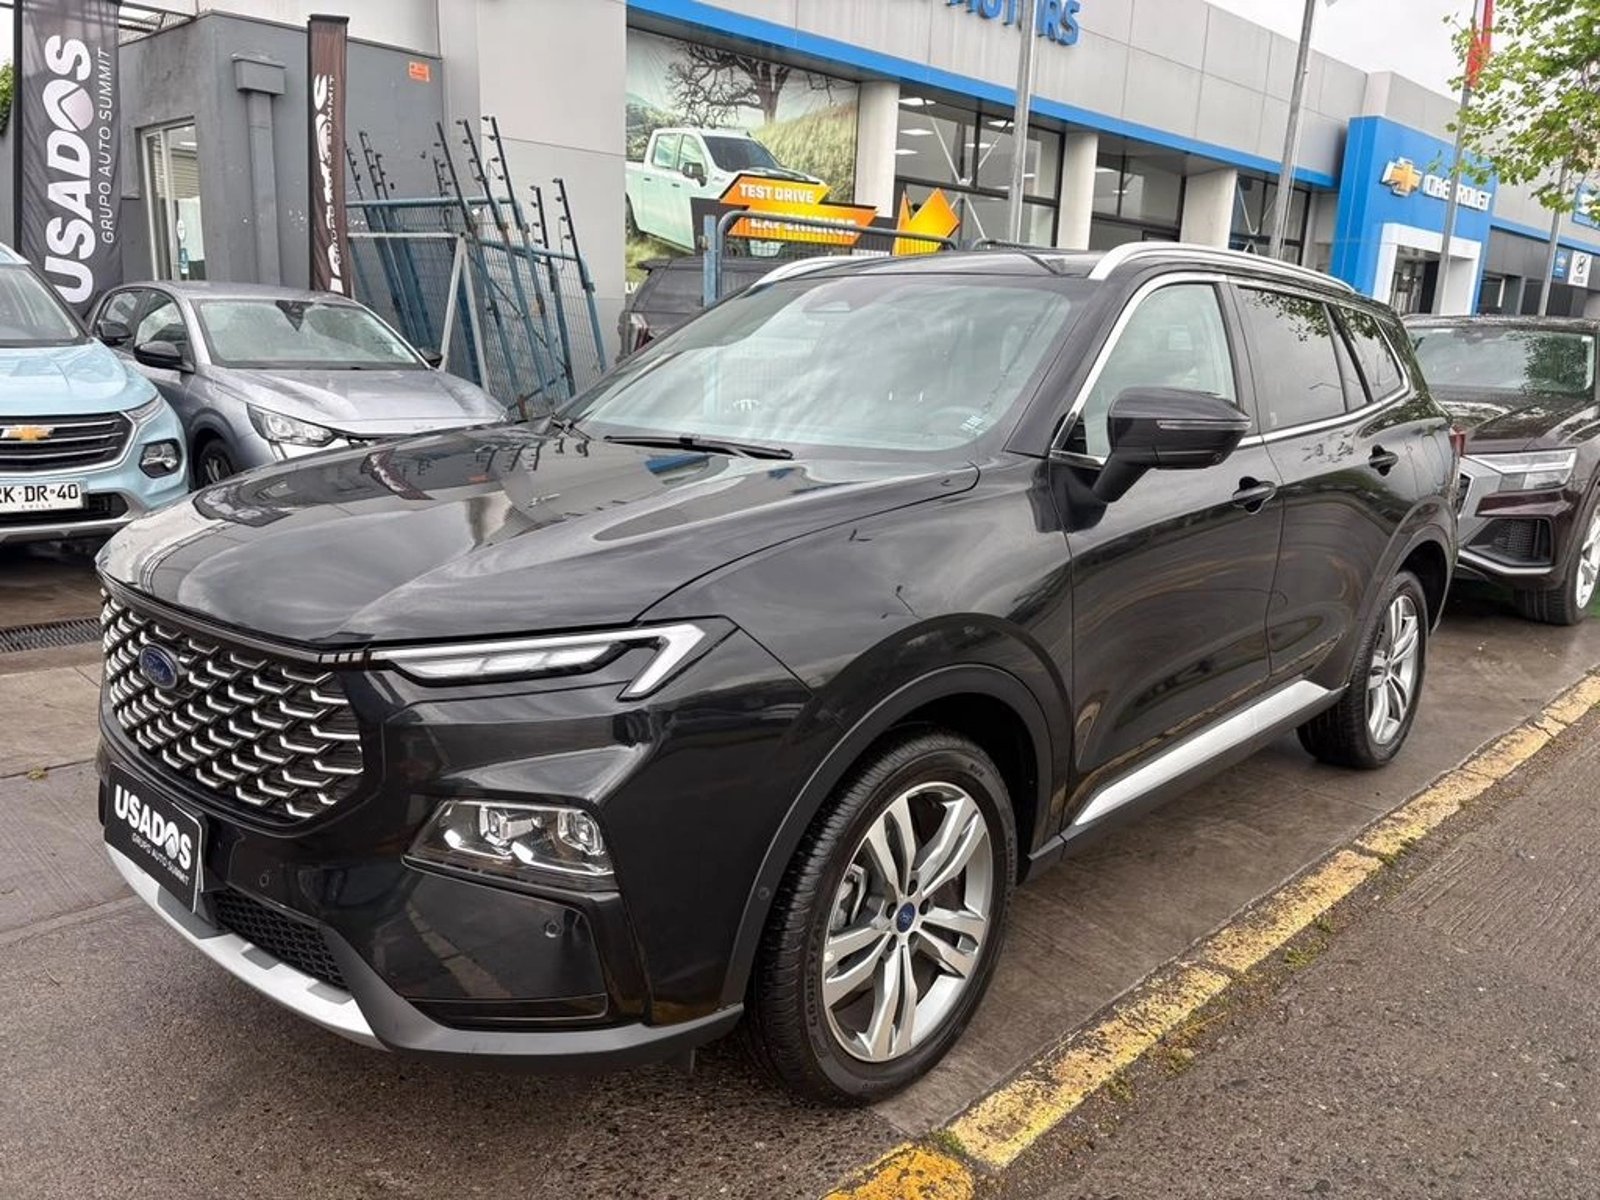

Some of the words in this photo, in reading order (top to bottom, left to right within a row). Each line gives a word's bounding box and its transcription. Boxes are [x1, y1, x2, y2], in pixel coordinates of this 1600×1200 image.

[98, 47, 113, 121] SUMMIT
[42, 35, 95, 304] USADOS
[98, 126, 112, 177] AUTO
[99, 182, 115, 244] GRUPO
[739, 184, 773, 200] TEST
[775, 187, 815, 204] DRIVE
[1423, 174, 1492, 211] CHEROLET
[115, 784, 192, 870] USADOS
